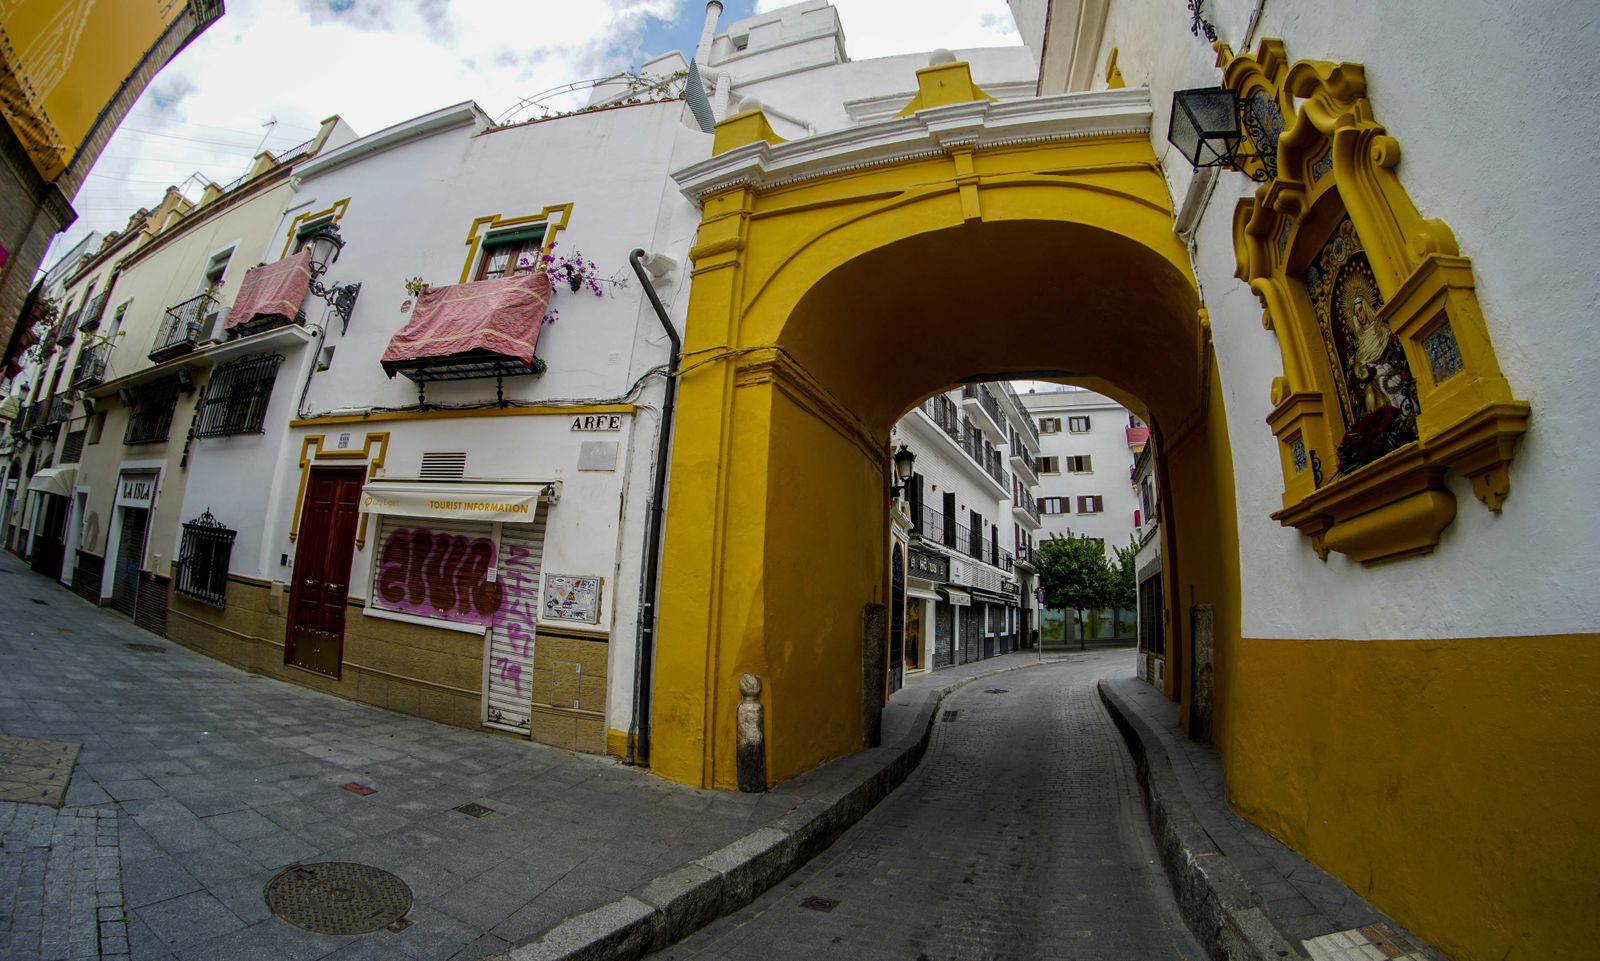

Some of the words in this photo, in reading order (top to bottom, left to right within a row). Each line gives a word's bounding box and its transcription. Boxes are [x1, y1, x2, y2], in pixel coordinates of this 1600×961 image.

[571, 415, 620, 430] ARFE
[123, 482, 133, 499] LA
[134, 482, 150, 500] ISLA
[430, 501, 462, 510] TOURIST
[464, 503, 529, 513] INFORMATION
